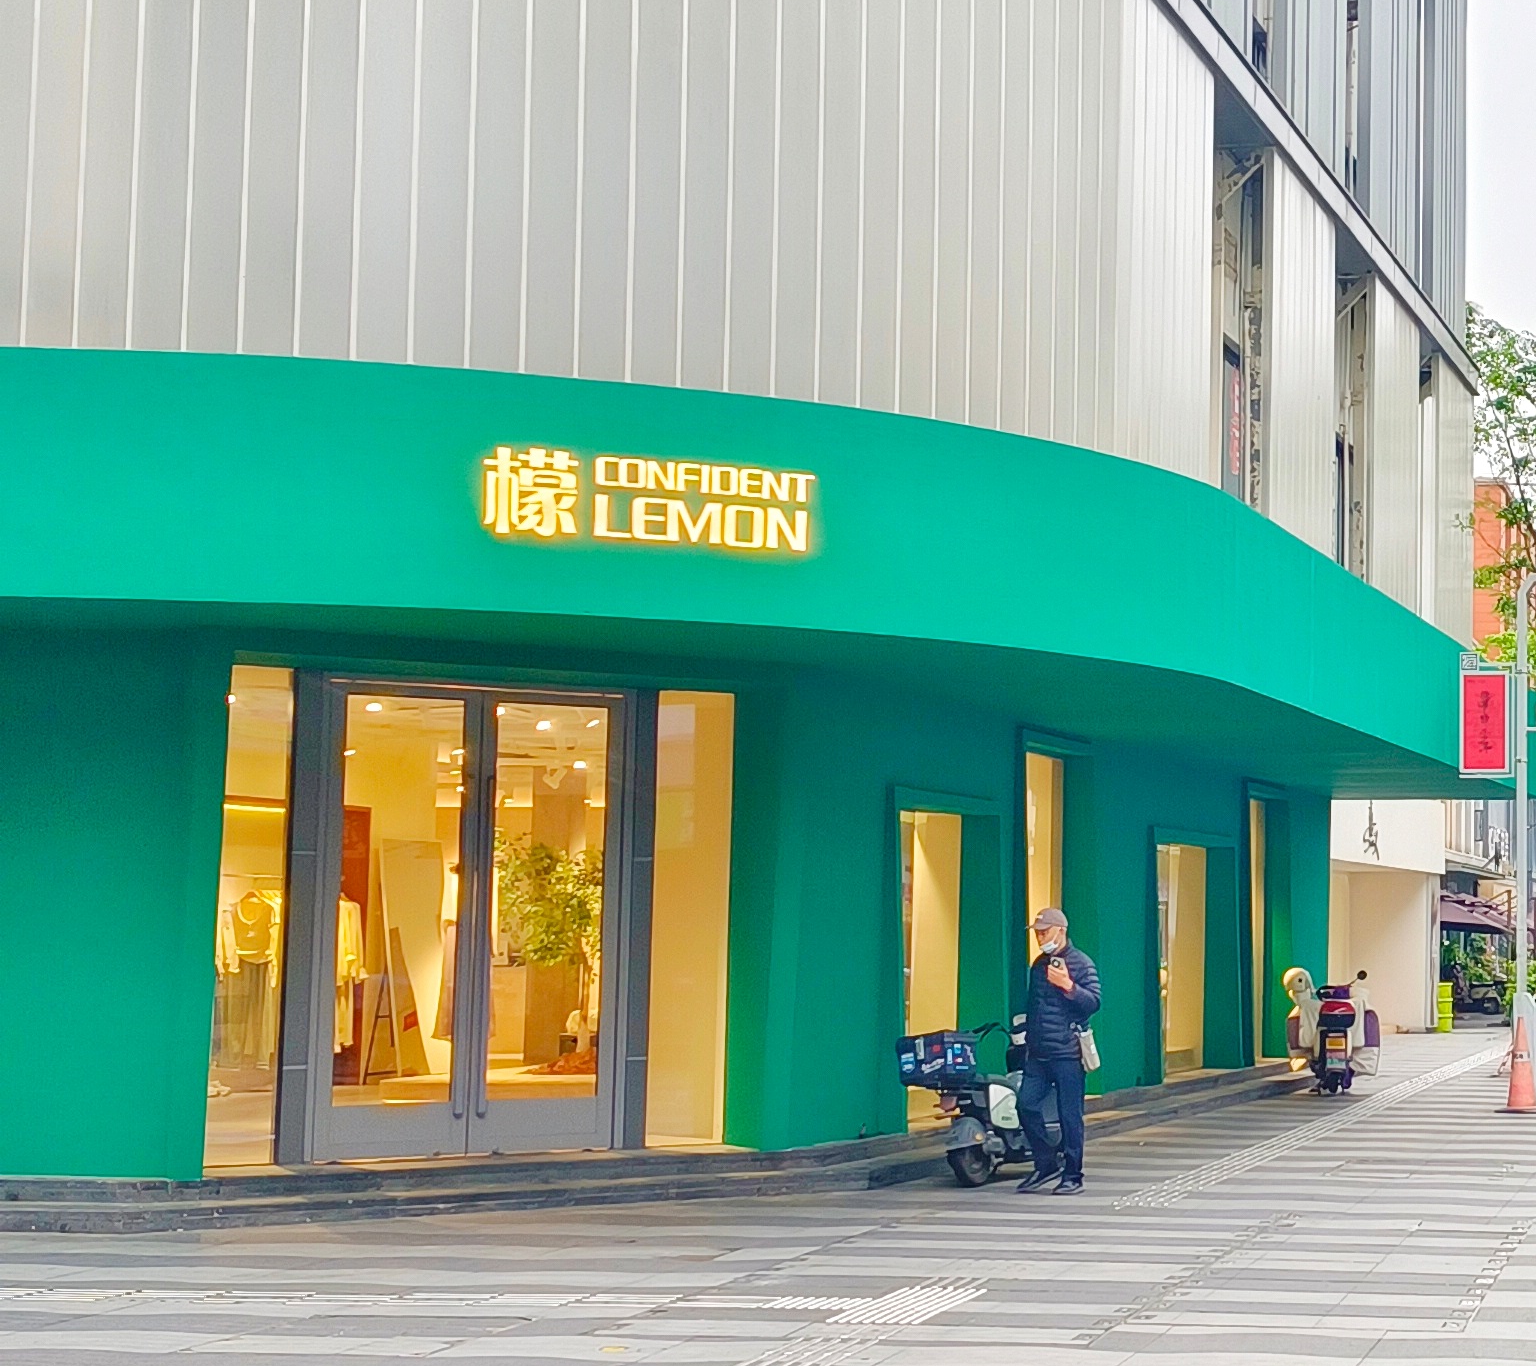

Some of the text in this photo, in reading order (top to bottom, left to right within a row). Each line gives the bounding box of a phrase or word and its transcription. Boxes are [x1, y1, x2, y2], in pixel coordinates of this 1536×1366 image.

[483, 446, 579, 537] 檬
[595, 456, 815, 503] CONFIDENT
[593, 493, 808, 552] LEMON
